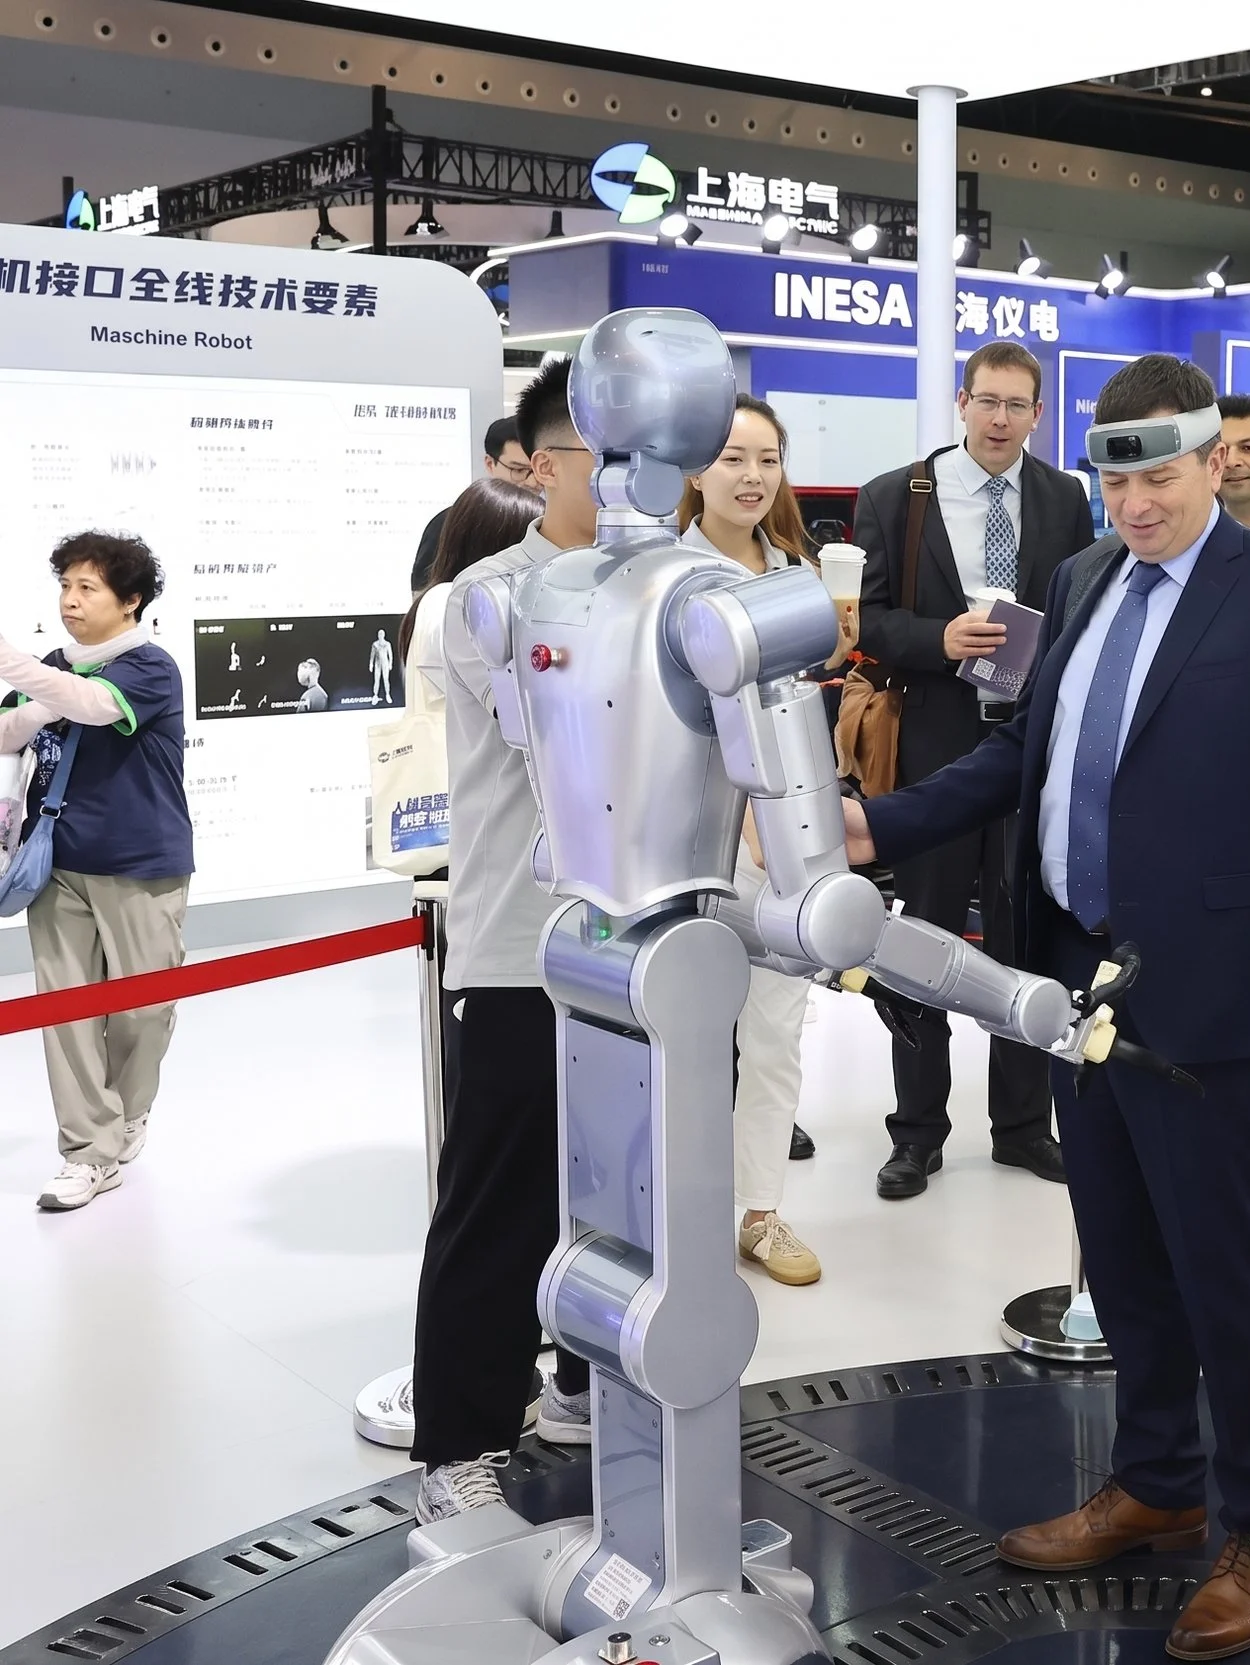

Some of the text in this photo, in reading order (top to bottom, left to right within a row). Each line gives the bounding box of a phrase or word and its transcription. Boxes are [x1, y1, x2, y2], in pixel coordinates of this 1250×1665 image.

[686, 166, 840, 220] 上海电气
[0, 257, 379, 318] 机接口全线技术要素
[774, 272, 913, 328] INESA
[90, 325, 253, 350] Maschine Robot
[954, 290, 1060, 342] 海仪电
